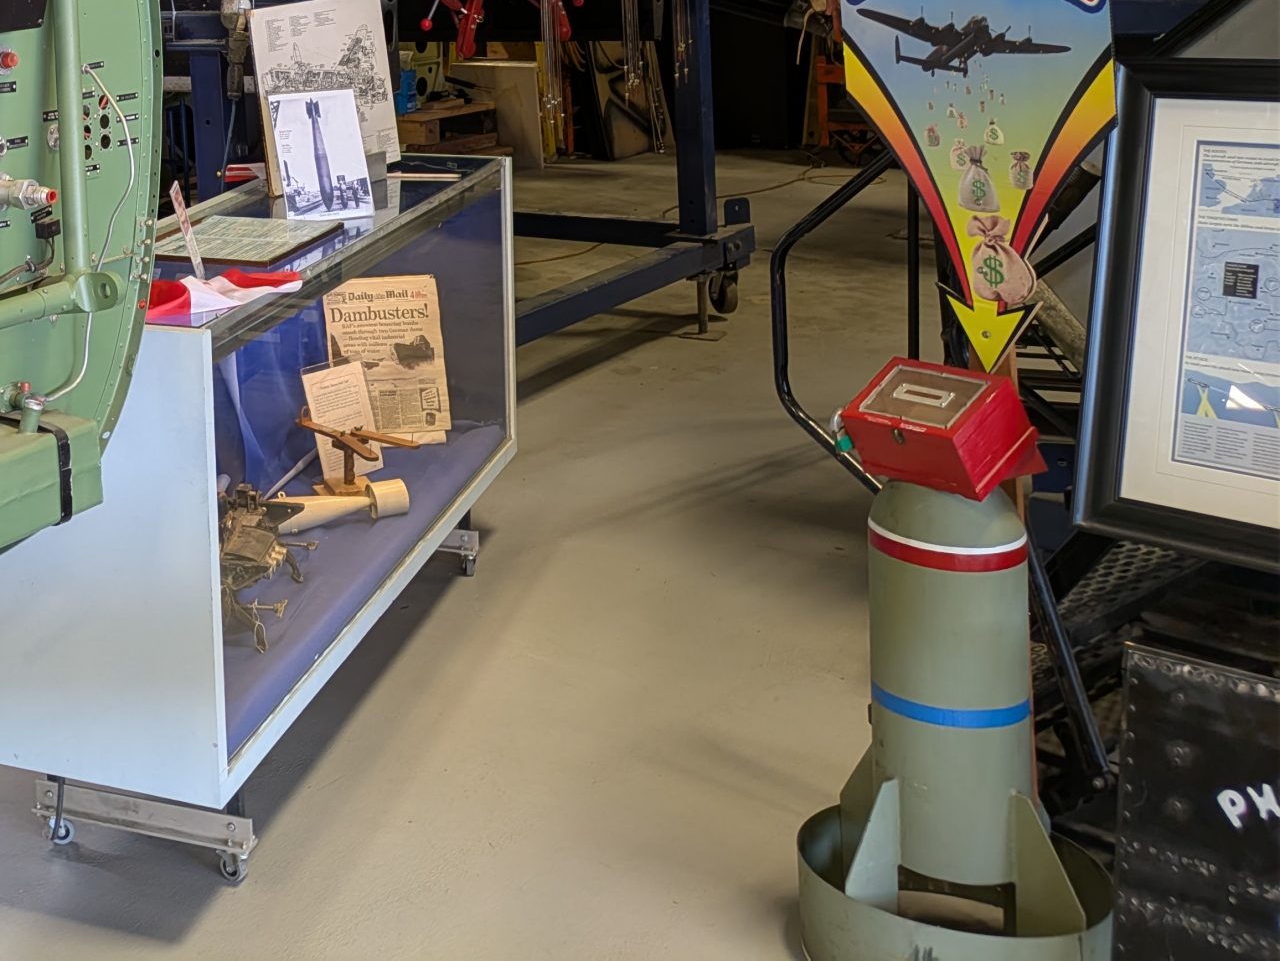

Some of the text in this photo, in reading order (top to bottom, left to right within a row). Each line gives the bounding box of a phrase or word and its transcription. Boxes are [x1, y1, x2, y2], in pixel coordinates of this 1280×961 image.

[348, 292, 373, 302] Daily
[385, 290, 408, 299] Mail
[329, 303, 429, 323] Dambusters!
